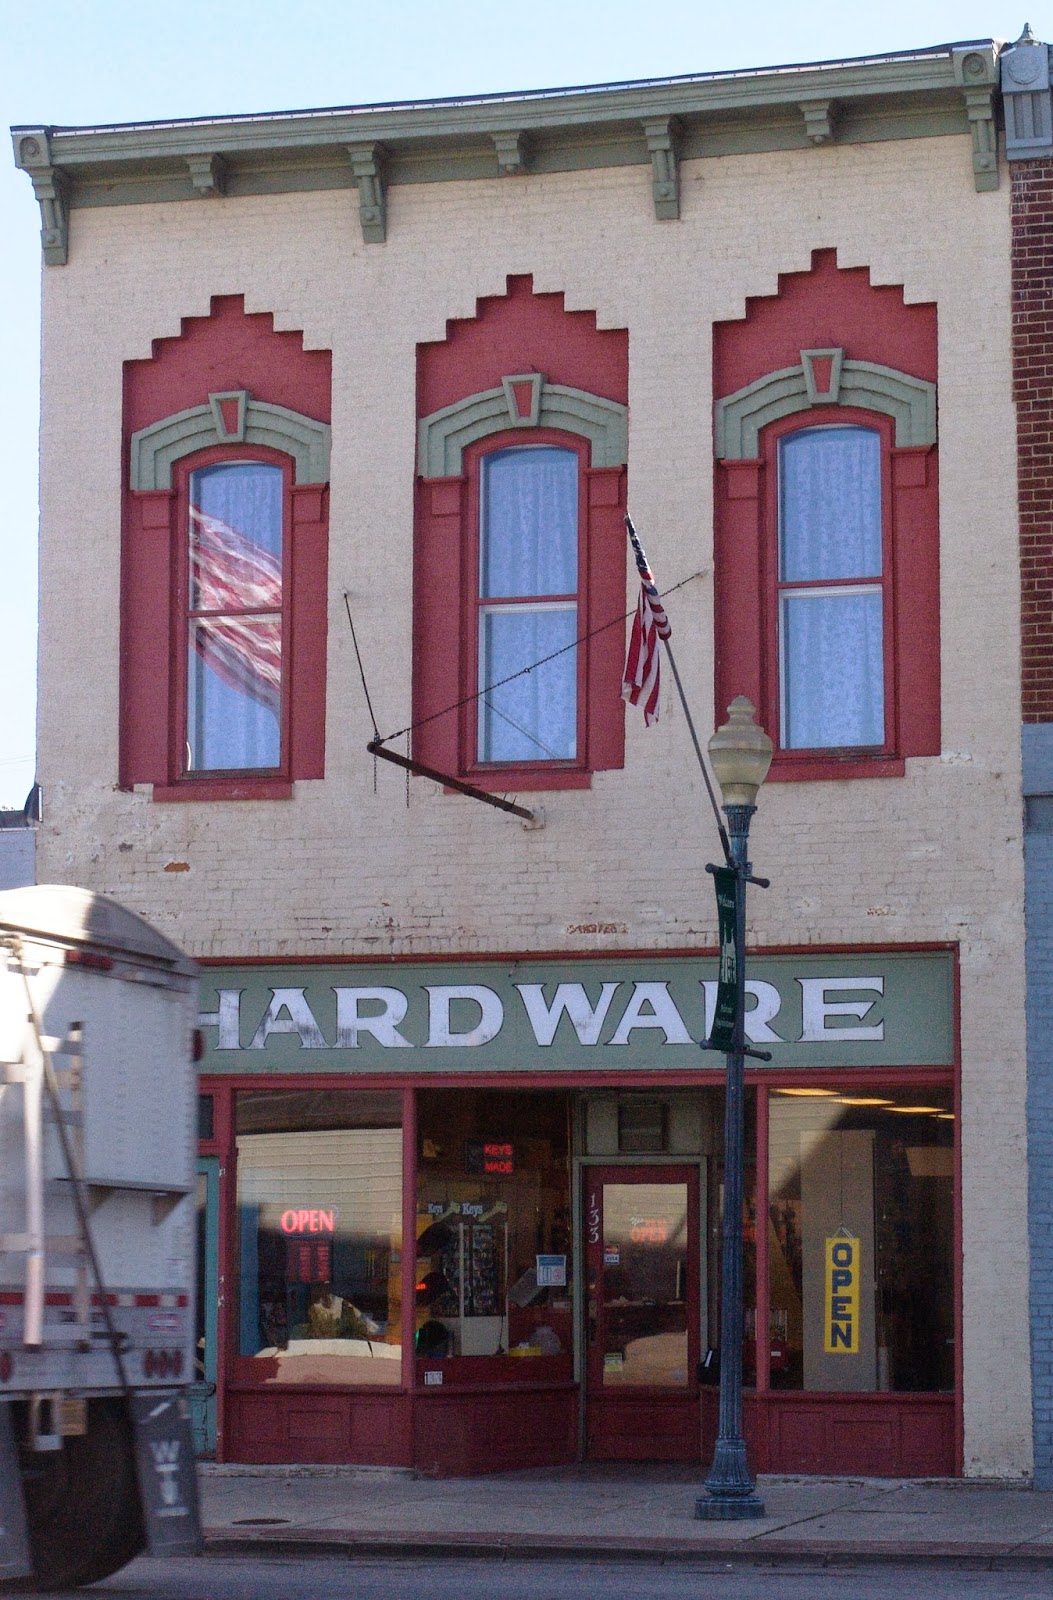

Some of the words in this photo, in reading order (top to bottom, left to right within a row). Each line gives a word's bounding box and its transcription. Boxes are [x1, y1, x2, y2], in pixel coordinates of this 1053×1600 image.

[484, 1144, 513, 1156] KEYS
[485, 1161, 513, 1173] MADE
[427, 1203, 443, 1215] Keys
[461, 1203, 483, 1217] Keys
[281, 1209, 334, 1233] OPEN
[588, 1193, 600, 1244] 133
[831, 1242, 853, 1348] OPEN
